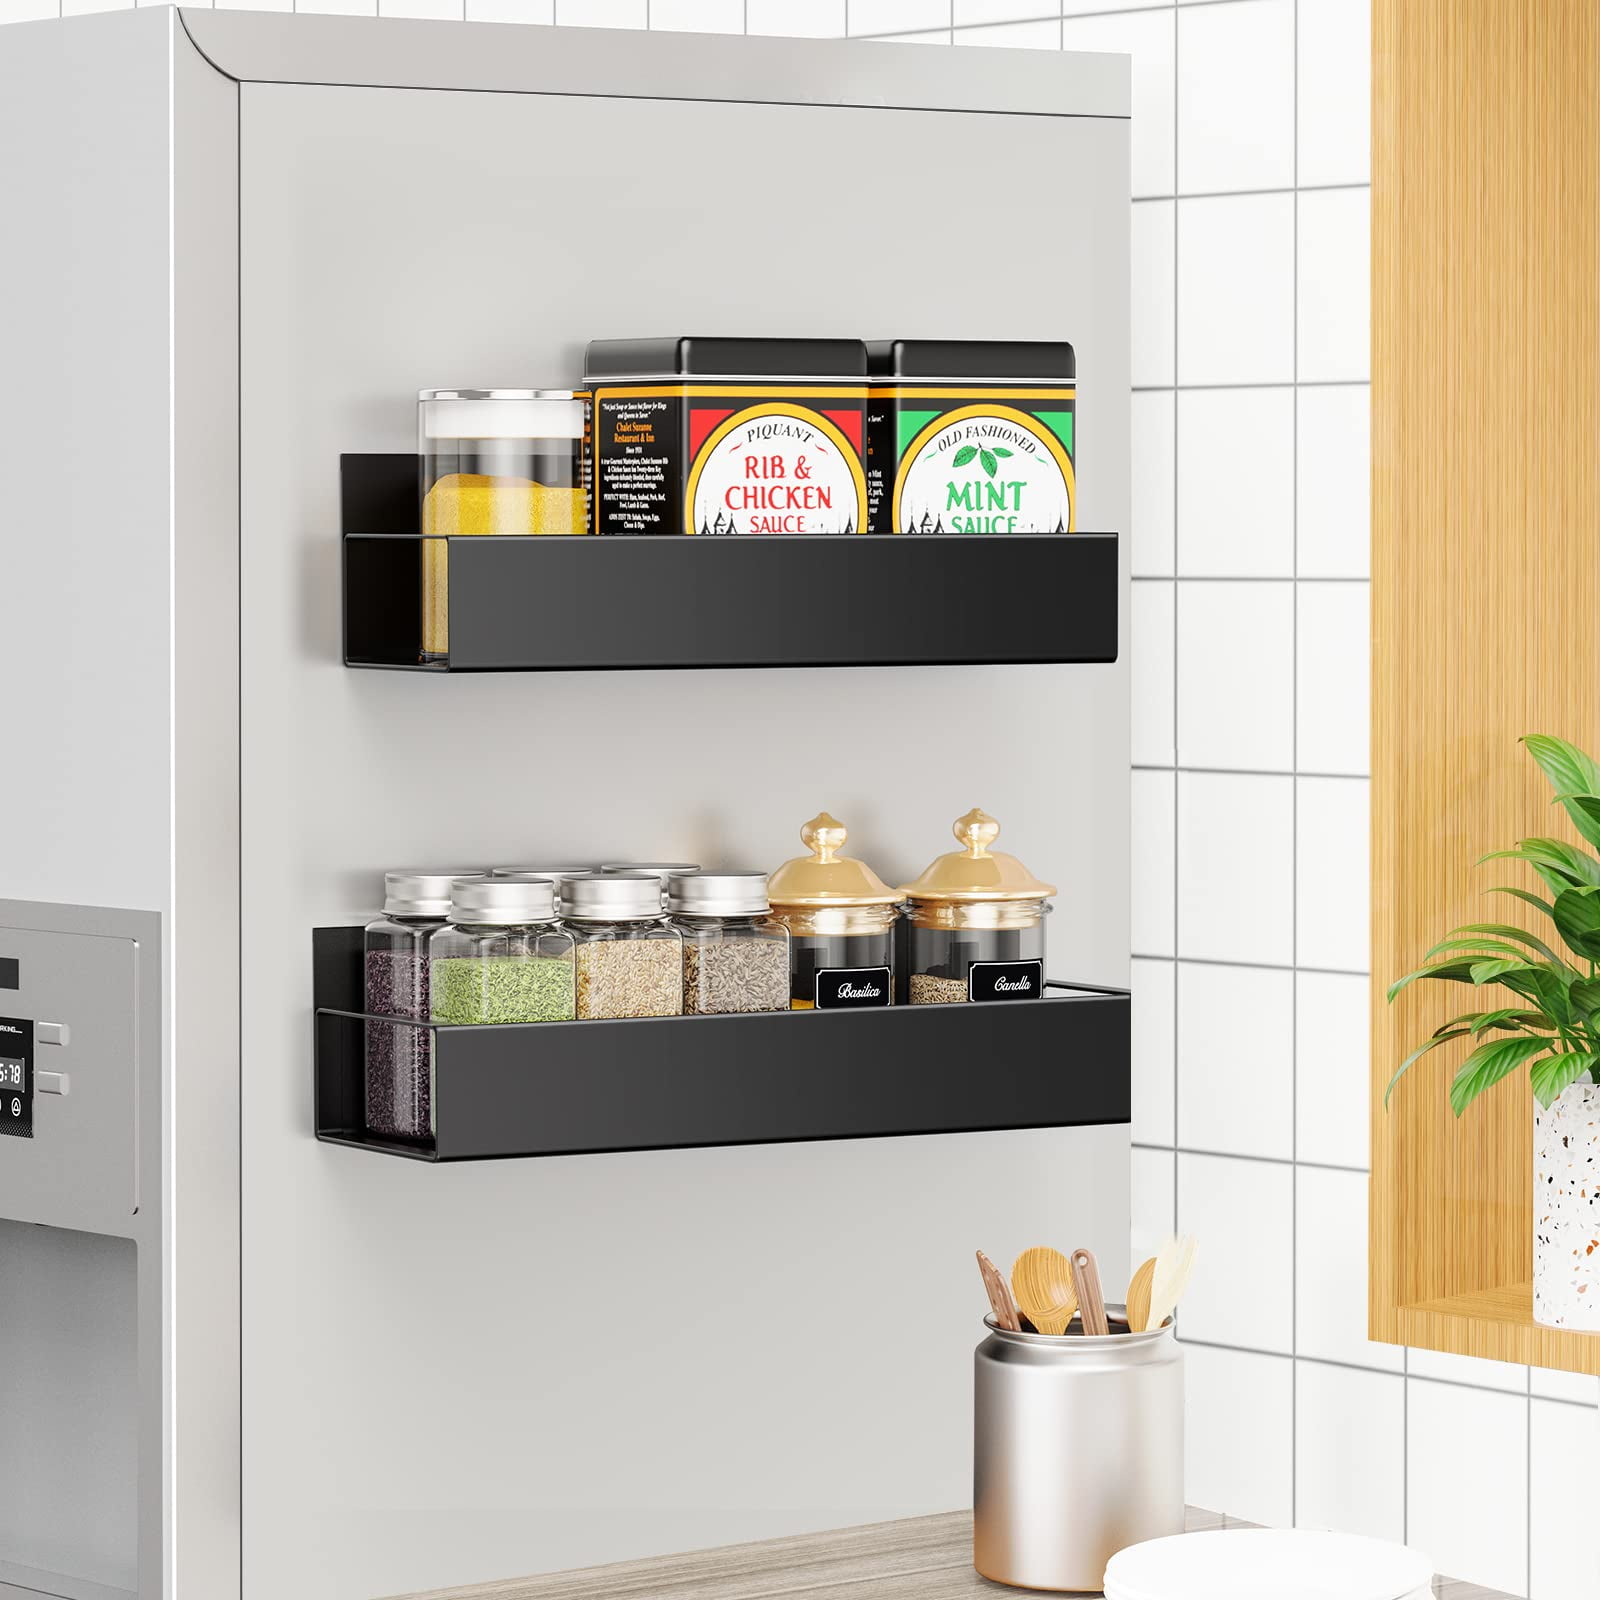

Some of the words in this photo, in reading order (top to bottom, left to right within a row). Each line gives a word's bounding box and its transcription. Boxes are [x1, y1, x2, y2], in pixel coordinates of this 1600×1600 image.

[616, 422, 632, 432] Chalet
[632, 422, 652, 432] Suzanne
[746, 423, 814, 443] PIQUANT
[614, 433, 640, 443] Restaurant
[640, 433, 645, 443] &
[646, 433, 655, 443] Inn
[938, 430, 962, 452] OLD
[966, 424, 1037, 454] FASHIONED
[744, 455, 787, 479] RIB
[794, 455, 812, 480] &
[724, 486, 832, 510] CHICKEN
[946, 480, 1028, 512] MINT
[750, 515, 806, 533] SAUCE
[951, 516, 1018, 534] SAUCE
[994, 975, 1032, 992] Canella
